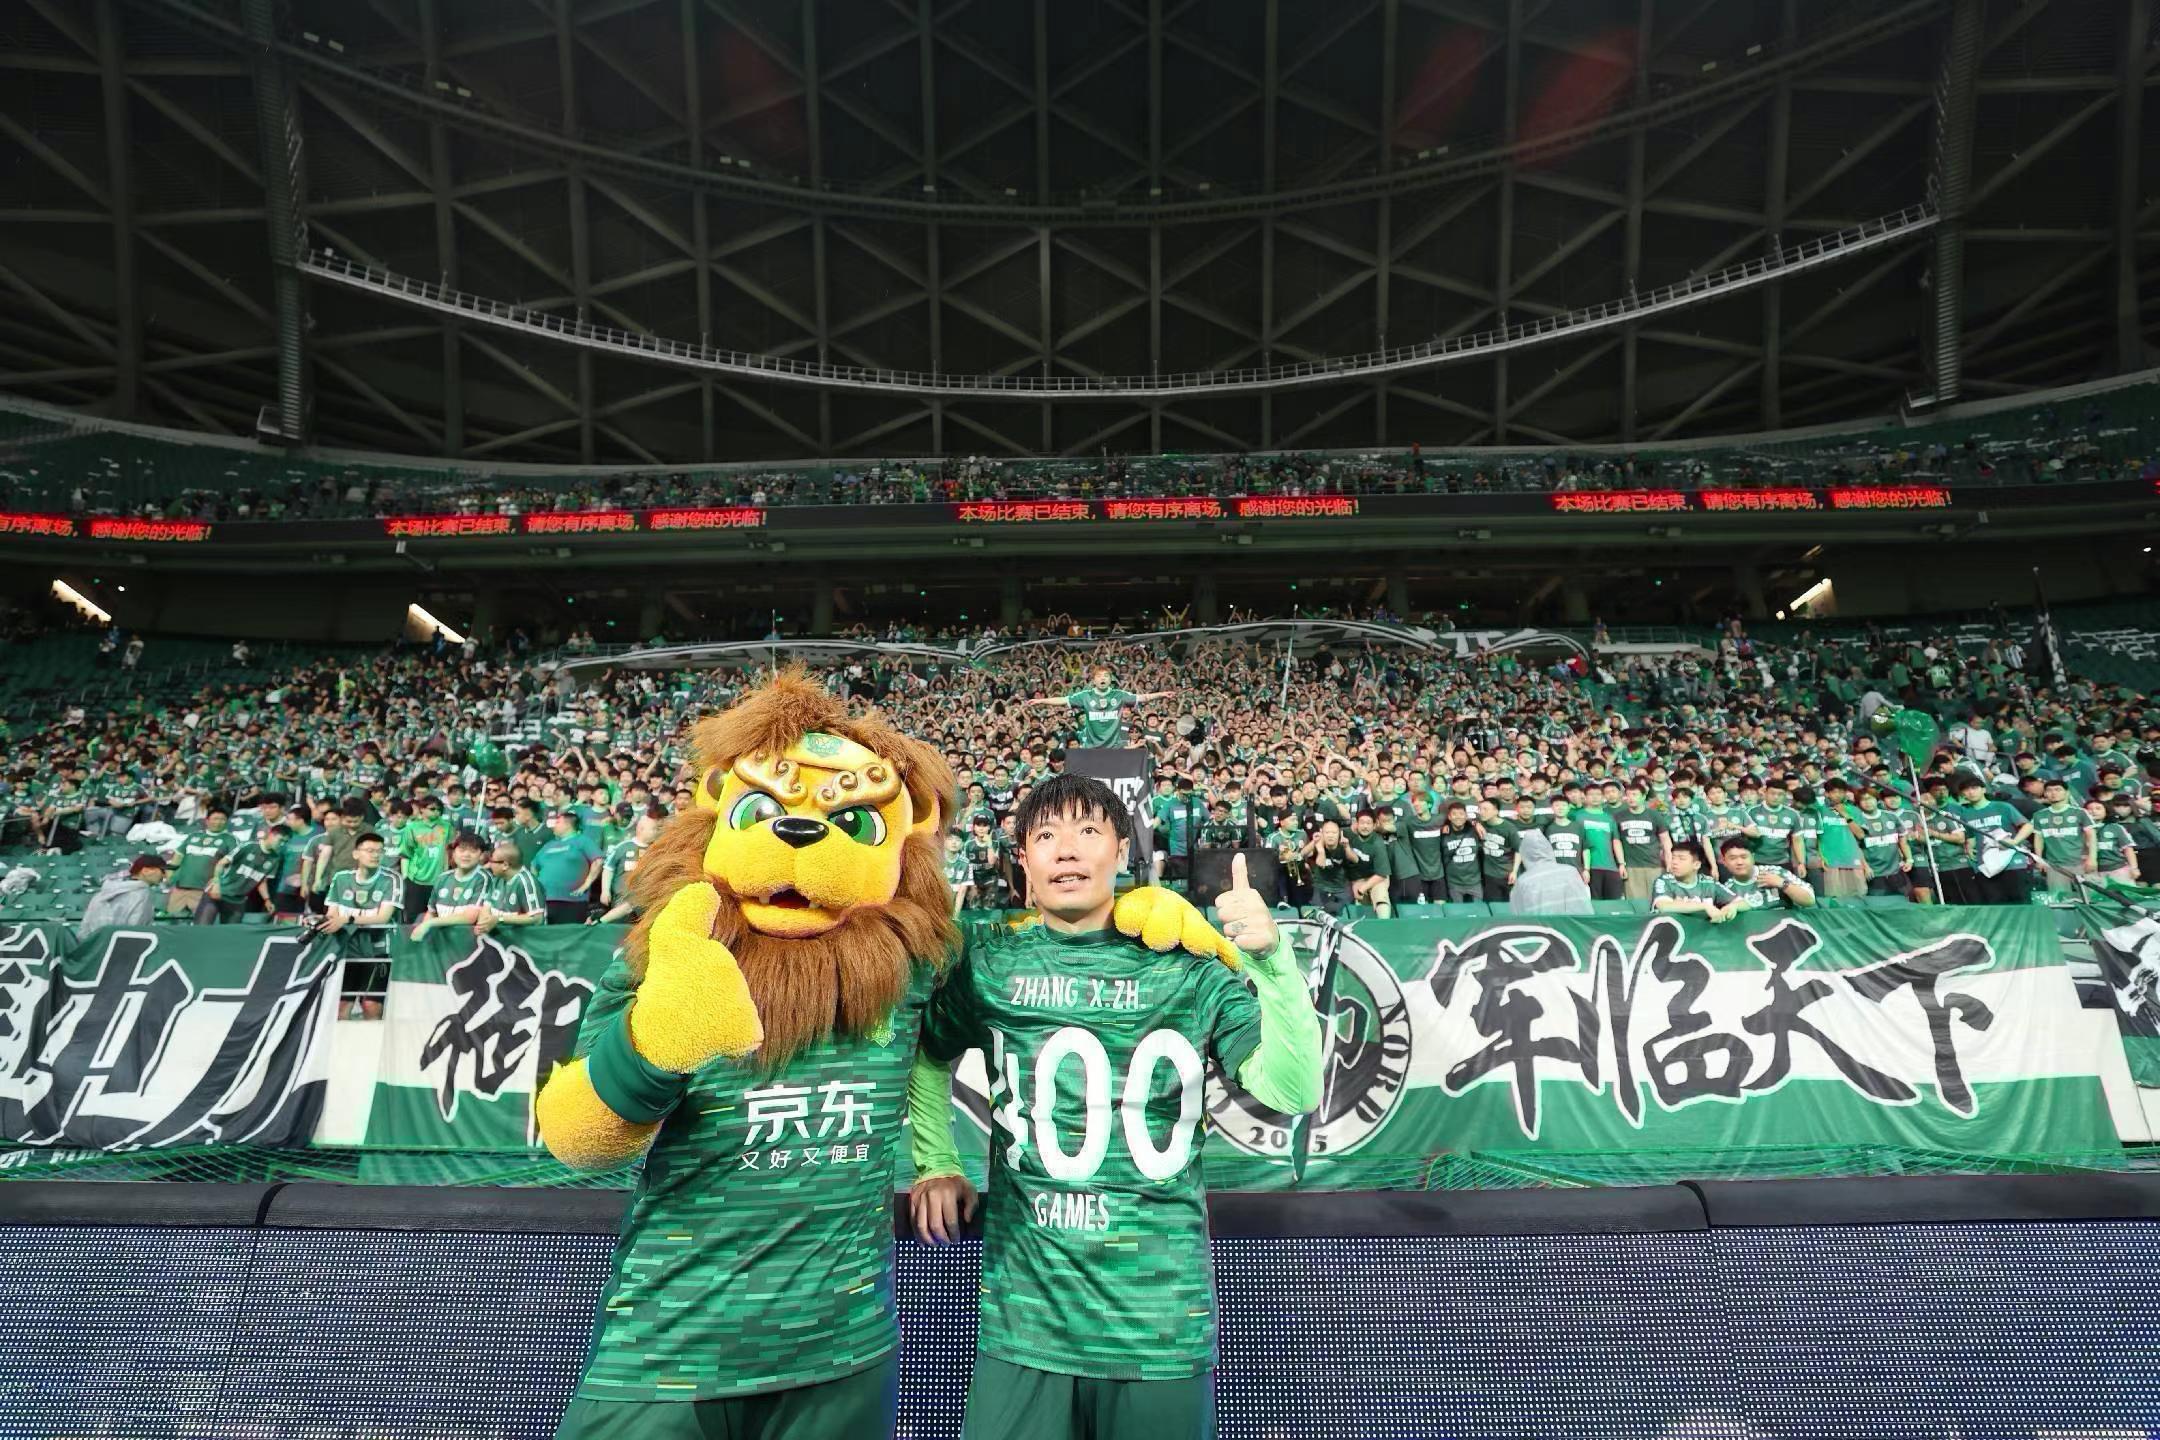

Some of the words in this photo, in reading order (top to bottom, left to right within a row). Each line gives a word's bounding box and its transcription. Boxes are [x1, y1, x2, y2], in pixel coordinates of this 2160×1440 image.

[959, 503, 1096, 522] 本场比赛已结束，
[1107, 501, 1228, 519] 请您有序离场，
[1240, 499, 1360, 517] 感谢您的光临！
[1011, 976, 1078, 1007] ZHANG
[743, 1080, 877, 1146] 京东
[1249, 1126, 1329, 1153] 205
[738, 1144, 871, 1171] 又好又便宜
[1034, 1192, 1111, 1232] GAMES
